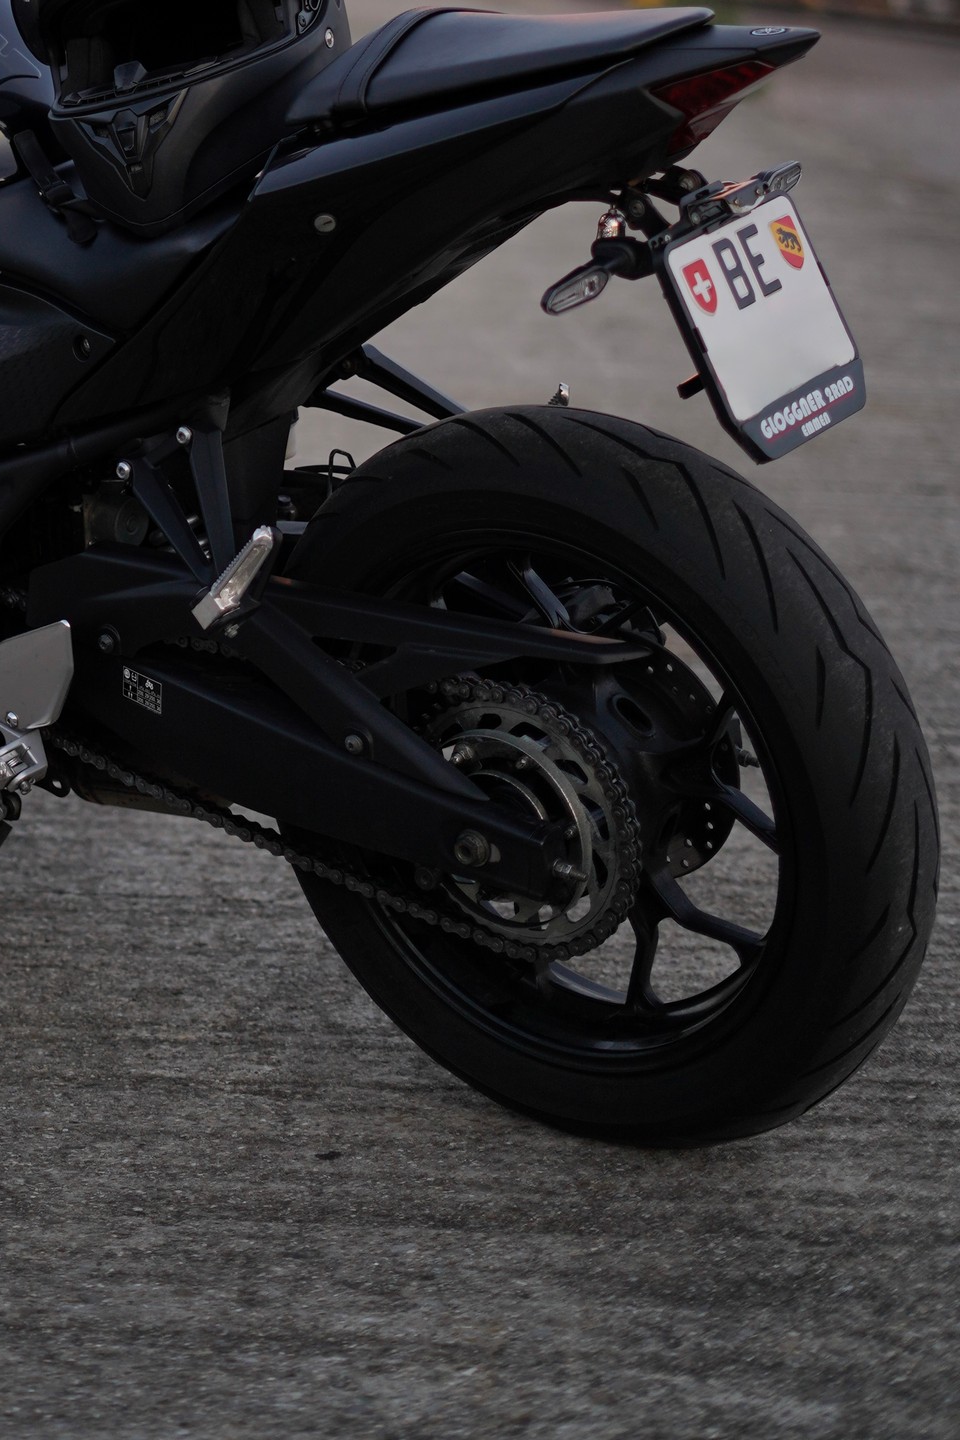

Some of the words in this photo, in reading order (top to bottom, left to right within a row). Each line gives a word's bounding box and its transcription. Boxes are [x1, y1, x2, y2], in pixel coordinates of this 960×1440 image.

[711, 223, 782, 310] BE
[760, 391, 824, 439] GLOGGNER
[826, 376, 854, 404] 2RAD
[801, 412, 831, 437] EMMEN
